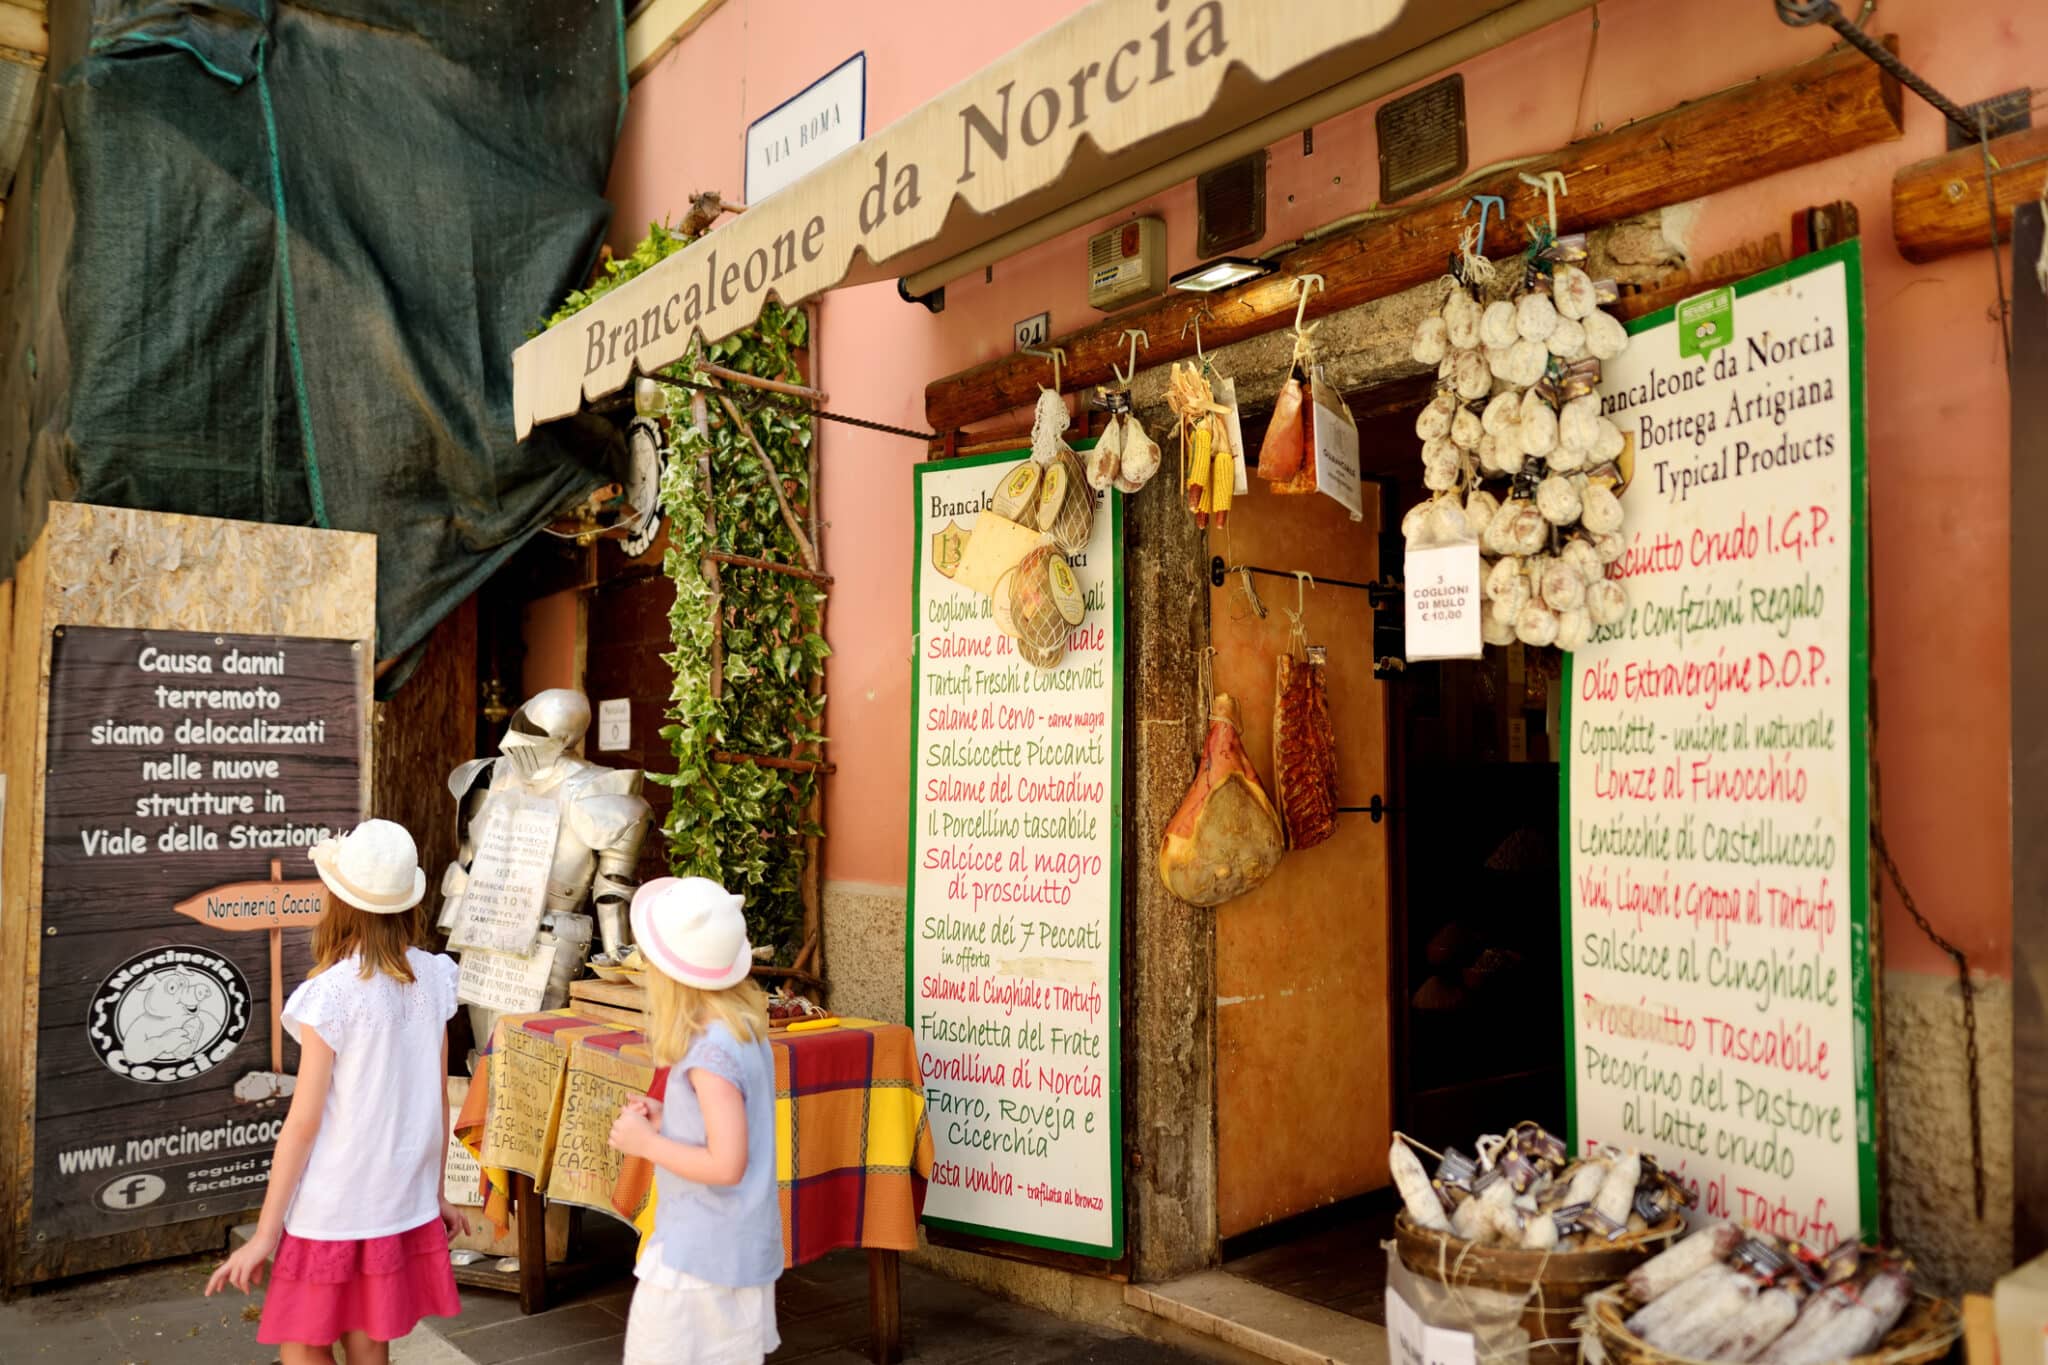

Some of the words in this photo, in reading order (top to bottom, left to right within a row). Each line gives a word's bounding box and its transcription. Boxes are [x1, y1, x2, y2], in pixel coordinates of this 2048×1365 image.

[763, 136, 791, 167] VIA
[800, 103, 841, 148] ROMA
[584, 214, 826, 377] Brancaleone
[859, 150, 921, 235] da
[956, 0, 1229, 184] Norcia
[1601, 364, 1705, 416] rancaleone
[1714, 349, 1737, 381] da
[1747, 315, 1834, 373] Norcia
[1639, 410, 1717, 450] Bottega
[1725, 375, 1834, 428] Artigiana
[1654, 445, 1728, 504] Typical
[1736, 432, 1834, 477] Products
[931, 490, 993, 518] Brancale
[1604, 532, 1684, 580] osciutto
[1690, 511, 1759, 568] Crudo
[1413, 585, 1469, 598] COGLIONI
[1437, 575, 1444, 585] 3
[929, 591, 977, 632] Coglioni
[1417, 600, 1429, 610] DI
[1432, 597, 1466, 609] MULO
[1642, 579, 1745, 651] Confezioni
[1750, 572, 1825, 638] Regalo
[138, 647, 212, 674] Causa
[222, 647, 285, 676] danni
[928, 632, 991, 659] Salame
[997, 634, 1013, 656] al
[155, 685, 281, 710] terremoto
[927, 664, 972, 704] Tartufi
[976, 664, 1020, 696] Freschi
[1024, 671, 1030, 693] e
[1034, 659, 1104, 691] Conservati
[1582, 658, 1618, 701] Olio
[1624, 646, 1752, 710] Extravergine
[1758, 646, 1831, 688] D.O.P.
[91, 721, 164, 746] siamo
[175, 718, 325, 745] delocalizzati
[927, 704, 977, 732] Salame
[982, 702, 994, 730] al
[999, 705, 1034, 730] Cervo
[1048, 712, 1072, 728] carne
[1074, 712, 1105, 733] magra
[927, 738, 1021, 767] Salsiccette
[1027, 735, 1104, 766] Piccanti
[1580, 710, 1655, 773] Coppiette
[1673, 714, 1728, 752] uniche
[1733, 713, 1751, 751] al
[1755, 708, 1836, 751] naturale
[142, 754, 202, 781] nelle
[212, 758, 279, 779] nuove
[925, 774, 985, 803] Salame
[990, 772, 1013, 803] del
[1018, 771, 1104, 803] Contadino
[1594, 759, 1656, 802] Lonze
[1664, 755, 1684, 800] al
[1692, 751, 1807, 803] Finocchio
[136, 790, 253, 817] strutture
[265, 788, 285, 813] in
[81, 827, 146, 857] Viale
[158, 825, 218, 852] della
[228, 823, 332, 849] Stazione
[928, 809, 938, 836] Il
[943, 808, 1019, 839] Porcellino
[1024, 808, 1096, 840] tascabile
[1579, 813, 1670, 861] Lenticchie
[1677, 813, 1697, 861] di
[1703, 817, 1835, 870] Castelluccio
[923, 844, 1002, 872] Salcicce
[1009, 846, 1028, 872] al
[1035, 852, 1101, 884] magro
[207, 895, 276, 919] Norcineria
[281, 893, 321, 914] Coccia
[948, 873, 968, 900] di
[972, 875, 1071, 912] prosciutto
[1617, 867, 1670, 932] Liquori
[1674, 884, 1681, 919] e
[1685, 881, 1741, 945] Grappa
[1746, 879, 1762, 925] al
[1767, 877, 1837, 953] Tartufo
[922, 914, 986, 944] Salame
[991, 915, 1016, 945] dei
[1020, 922, 1035, 952] 7
[1040, 920, 1101, 949] Peccati
[108, 950, 235, 990] Norcineria
[942, 946, 954, 965] in
[956, 946, 990, 973] offerta
[1582, 928, 1670, 980] Salsicce
[1678, 938, 1700, 983] al
[1708, 940, 1838, 1012] Cinghiale
[921, 973, 965, 1003] Salame
[969, 975, 980, 1002] al
[983, 976, 1041, 1016] Cinghiale
[1045, 991, 1051, 1013] e
[1053, 981, 1101, 1024] Tartufo
[921, 1011, 1010, 1048] Fiaschetta
[1018, 1019, 1045, 1052] del
[1050, 1027, 1100, 1058] Frate
[1703, 1016, 1830, 1080] Tascabile
[106, 1038, 239, 1082] Coccia
[921, 1052, 1005, 1087] Corallina
[1012, 1059, 1032, 1089] di
[1039, 1064, 1101, 1098] Norcia
[926, 1088, 991, 1122] Farro,
[999, 1097, 1074, 1140] Roveja
[1084, 1110, 1095, 1133] e
[1585, 1045, 1682, 1101] Pecorino
[1691, 1064, 1728, 1112] del
[1736, 1078, 1843, 1143] Pastore
[948, 1120, 1047, 1158] Cicerchia
[1622, 1097, 1645, 1135] al
[1717, 1129, 1795, 1179] crudo
[188, 1160, 255, 1179] seguici
[932, 1160, 960, 1188] asta
[1027, 1182, 1062, 1208] trafilata
[1064, 1189, 1073, 1205] al
[1074, 1188, 1104, 1211] bronzo
[1707, 1174, 1731, 1219] al
[1736, 1186, 1840, 1250] Tartufo
